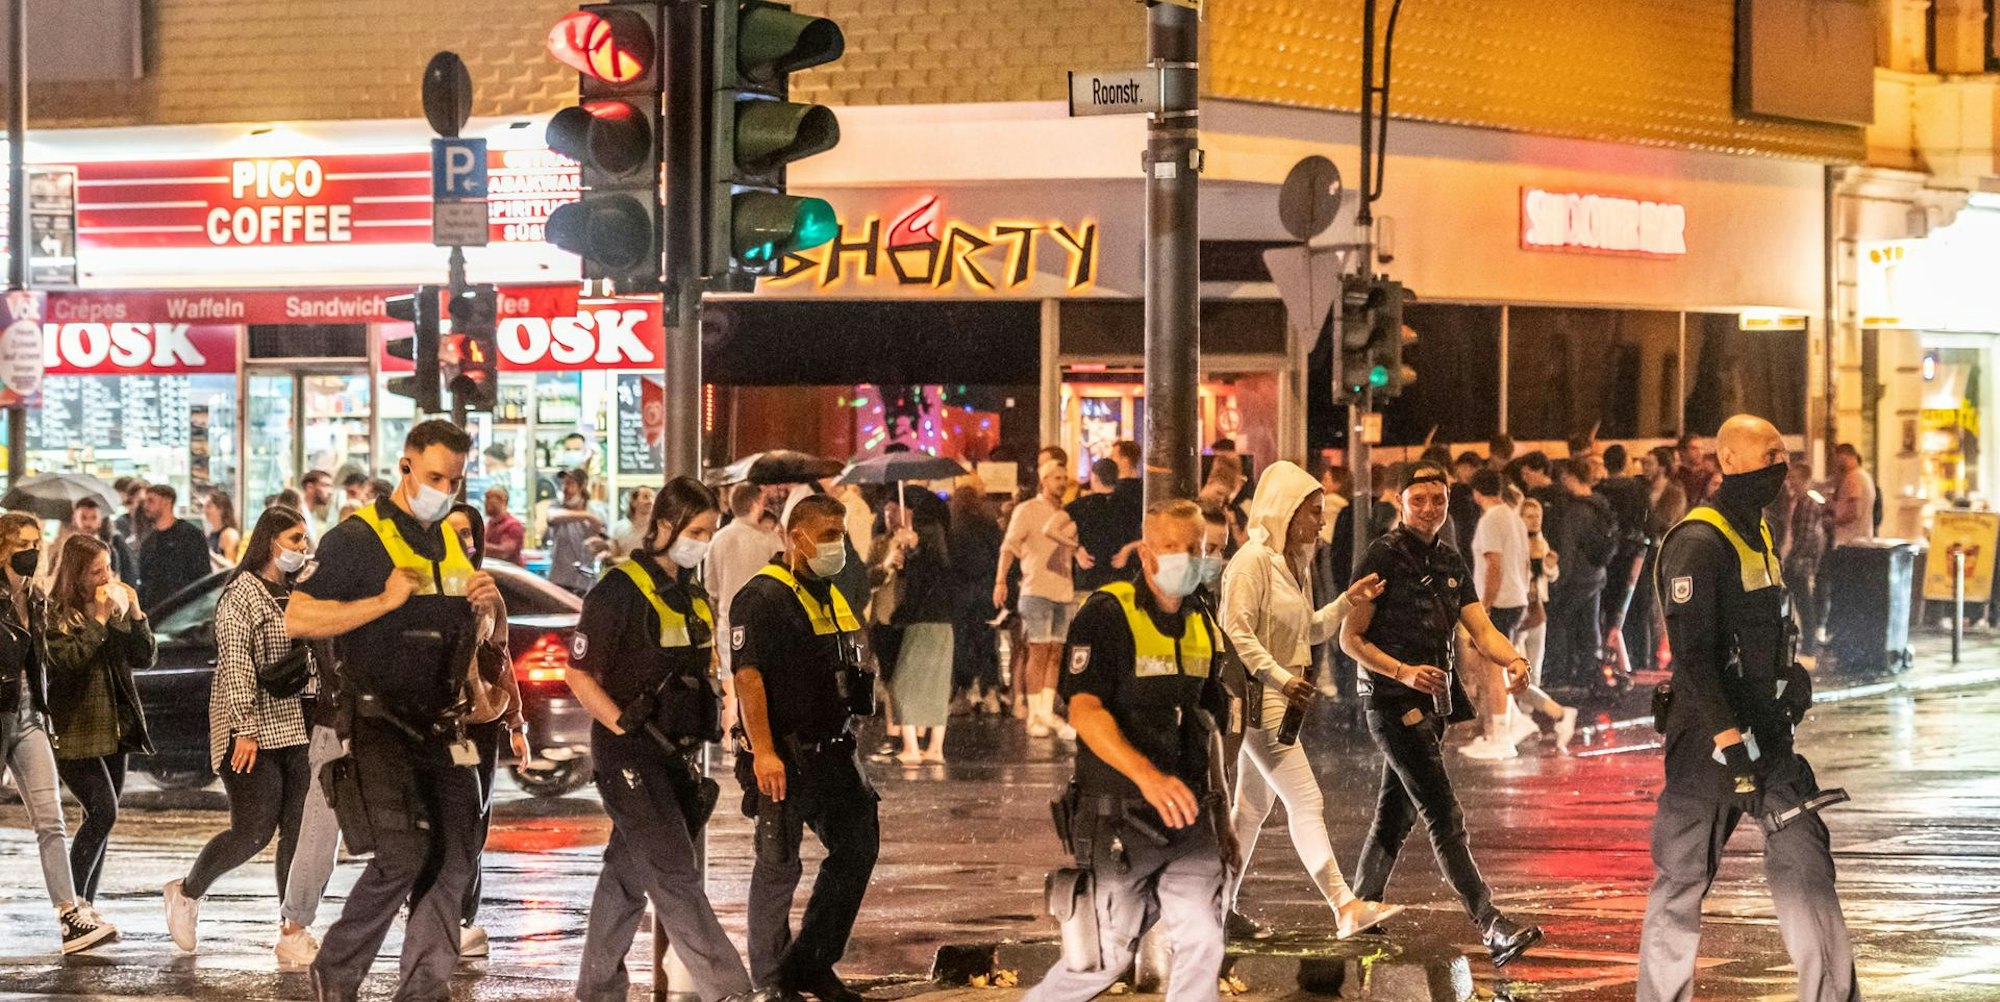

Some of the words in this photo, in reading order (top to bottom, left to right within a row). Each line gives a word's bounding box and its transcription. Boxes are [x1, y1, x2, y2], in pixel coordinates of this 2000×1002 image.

[1092, 77, 1144, 105] Roonstr.
[232, 158, 323, 198] PICO
[446, 146, 475, 192] P
[206, 204, 352, 245] COFFEE
[488, 198, 580, 219] PIRITU
[55, 299, 127, 322] Crêpes
[166, 297, 245, 319] Waffeln
[286, 295, 387, 318] Sandwich
[43, 323, 206, 368] IOSK
[496, 309, 655, 365] OSK
